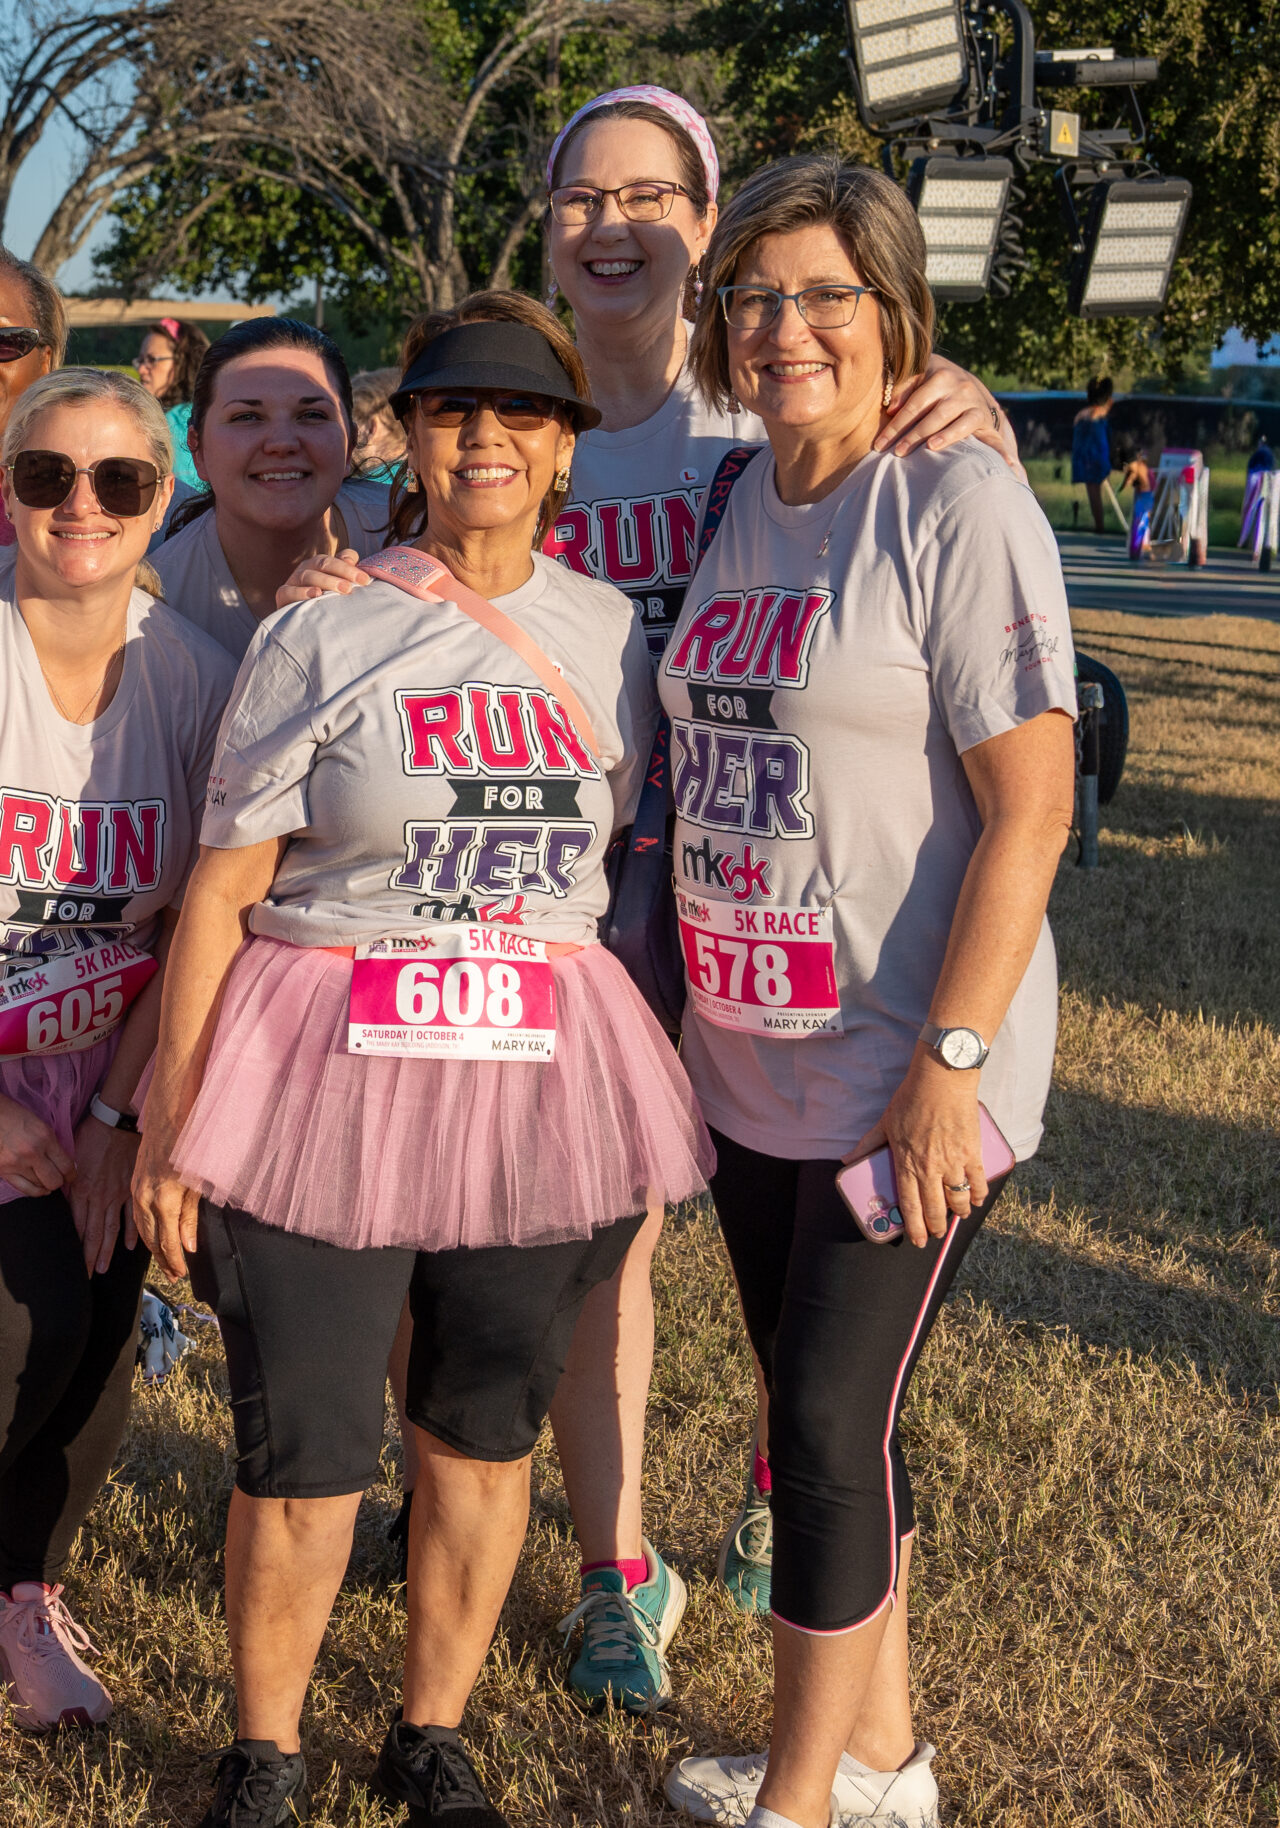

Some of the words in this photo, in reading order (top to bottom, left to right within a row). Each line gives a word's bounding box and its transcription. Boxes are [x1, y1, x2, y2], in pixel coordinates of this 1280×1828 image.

[685, 471, 696, 481] L
[709, 447, 759, 517] MARY
[666, 587, 835, 690] RUN
[706, 694, 748, 720] FOR
[394, 681, 601, 779] RUN
[647, 730, 666, 789] KAY
[671, 717, 815, 841] HER
[484, 785, 543, 810] FOR
[389, 820, 597, 897] HER
[681, 836, 774, 902] mk5k
[43, 900, 96, 921] FOR
[734, 909, 759, 933] 5K
[763, 912, 820, 936] RACE
[469, 928, 496, 952] 5K
[499, 932, 537, 957] RACE
[74, 955, 102, 979] 5K
[695, 931, 793, 1007] 578
[27, 974, 123, 1050] 605
[396, 961, 523, 1027] 608
[362, 1029, 408, 1040] SATURDAY
[416, 1031, 457, 1041] OCTOBER
[458, 1032, 464, 1041] 4
[491, 1039, 525, 1051] MARY
[528, 1040, 545, 1051] KAY
[763, 1017, 798, 1030] MARY
[802, 1018, 828, 1030] KAY
